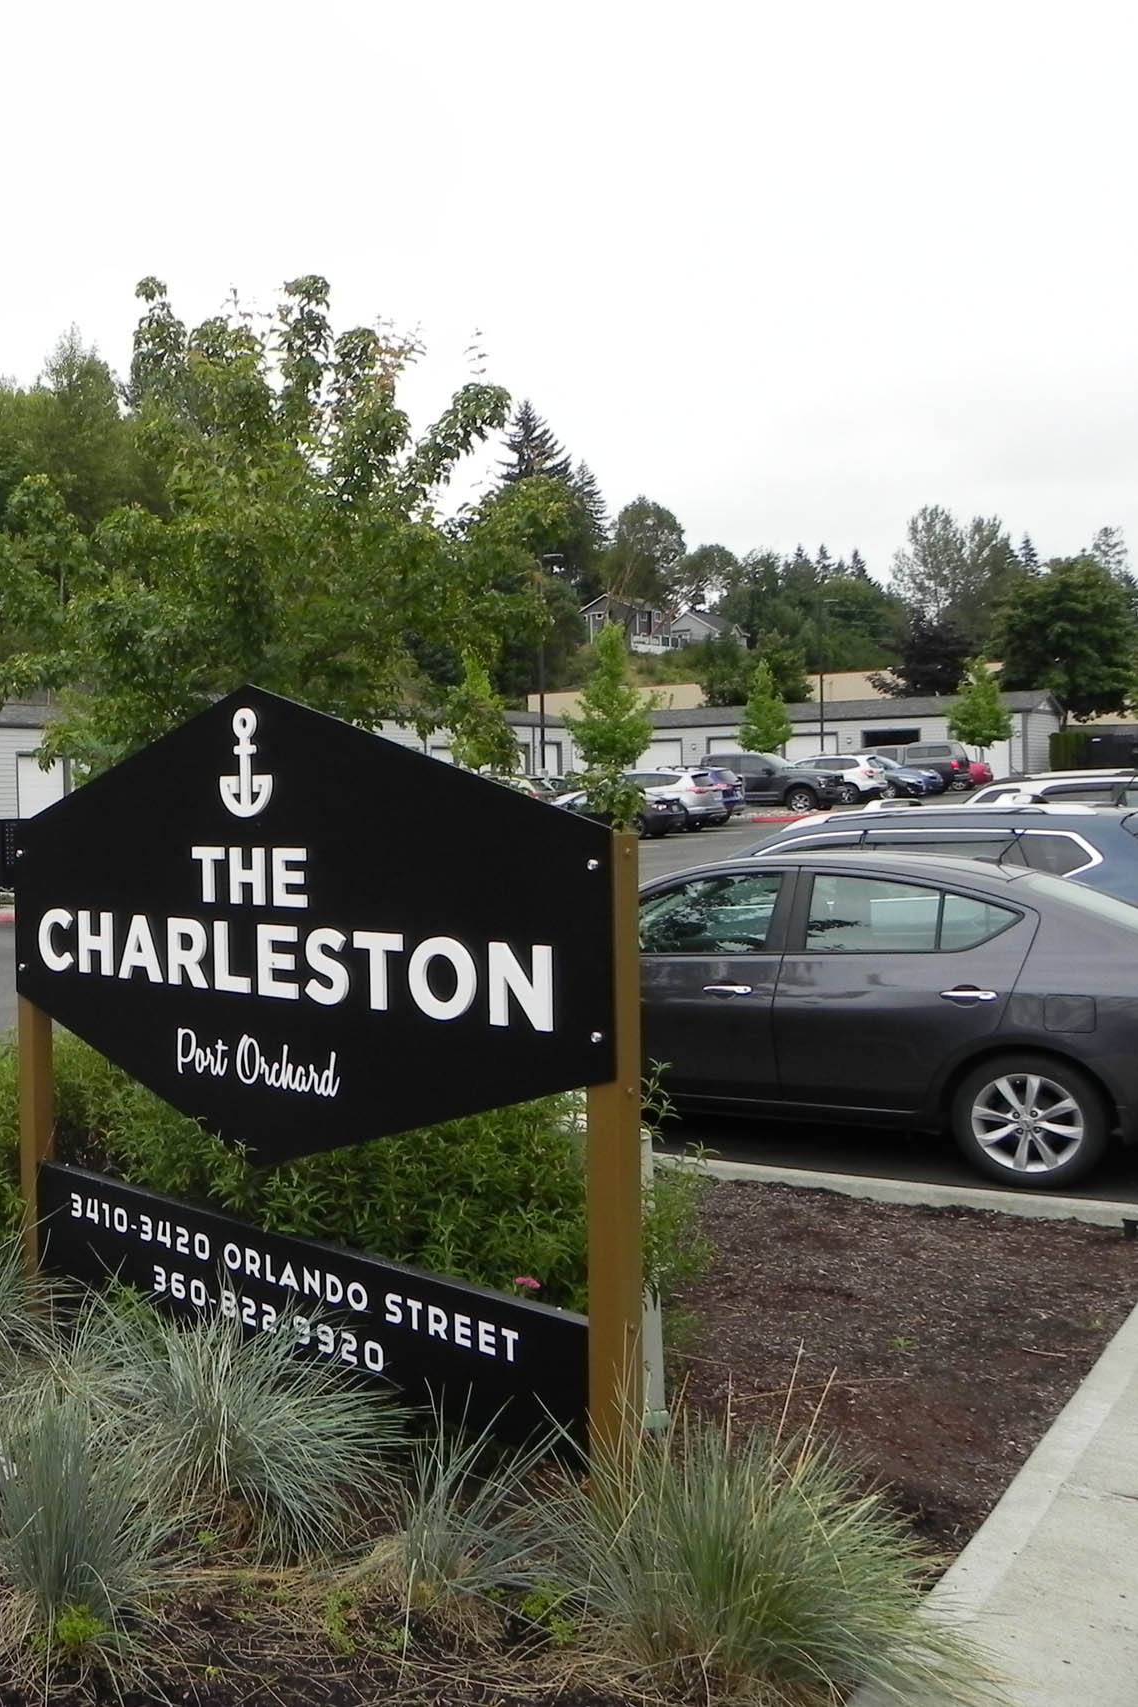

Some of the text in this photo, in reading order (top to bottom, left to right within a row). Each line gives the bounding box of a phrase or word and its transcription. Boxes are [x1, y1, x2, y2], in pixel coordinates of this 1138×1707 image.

[191, 846, 309, 908] THE
[38, 907, 555, 1032] CHARLESTON
[177, 1027, 341, 1098] Port Orchard
[70, 1192, 521, 1363] 3410-3420 ORLANDO STREET
